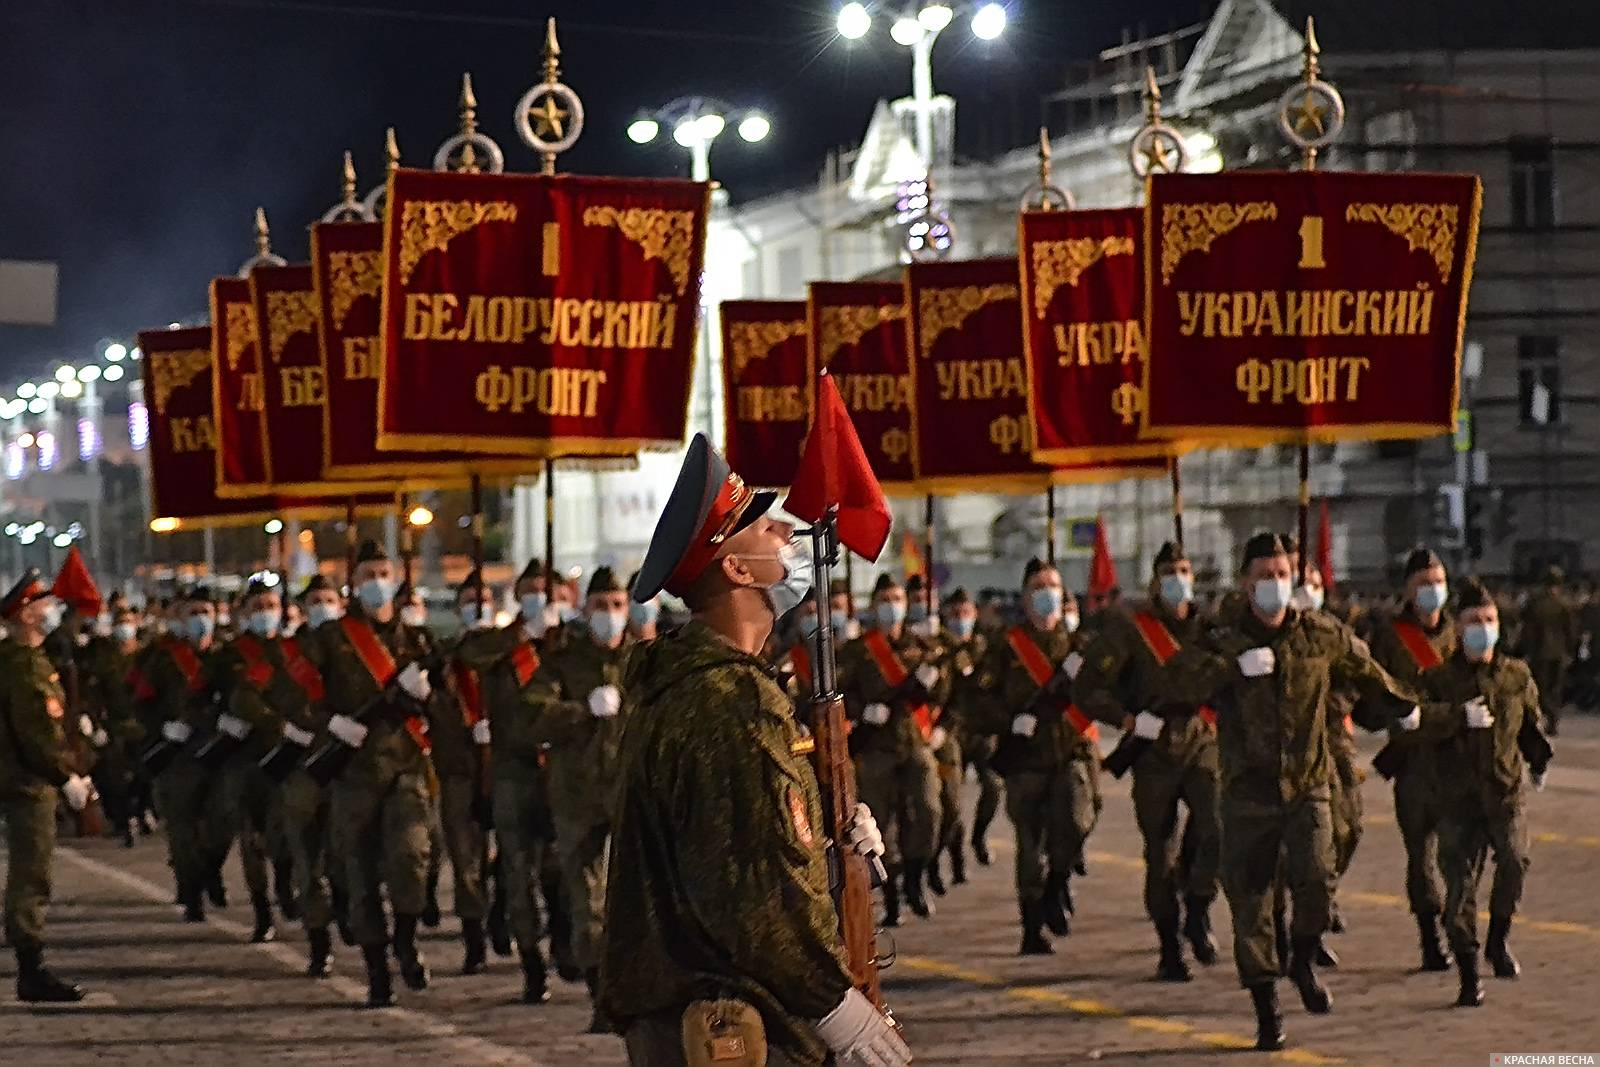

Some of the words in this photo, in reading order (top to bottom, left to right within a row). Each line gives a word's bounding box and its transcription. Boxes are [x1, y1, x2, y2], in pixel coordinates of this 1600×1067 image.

[1297, 215, 1327, 270] 1
[404, 293, 679, 349] БЕЛОРУССКИЙ
[1177, 282, 1434, 337] УКРАИНСКИЙ
[475, 365, 606, 417] ФРОНТ
[1236, 355, 1370, 405] ФРОНТ
